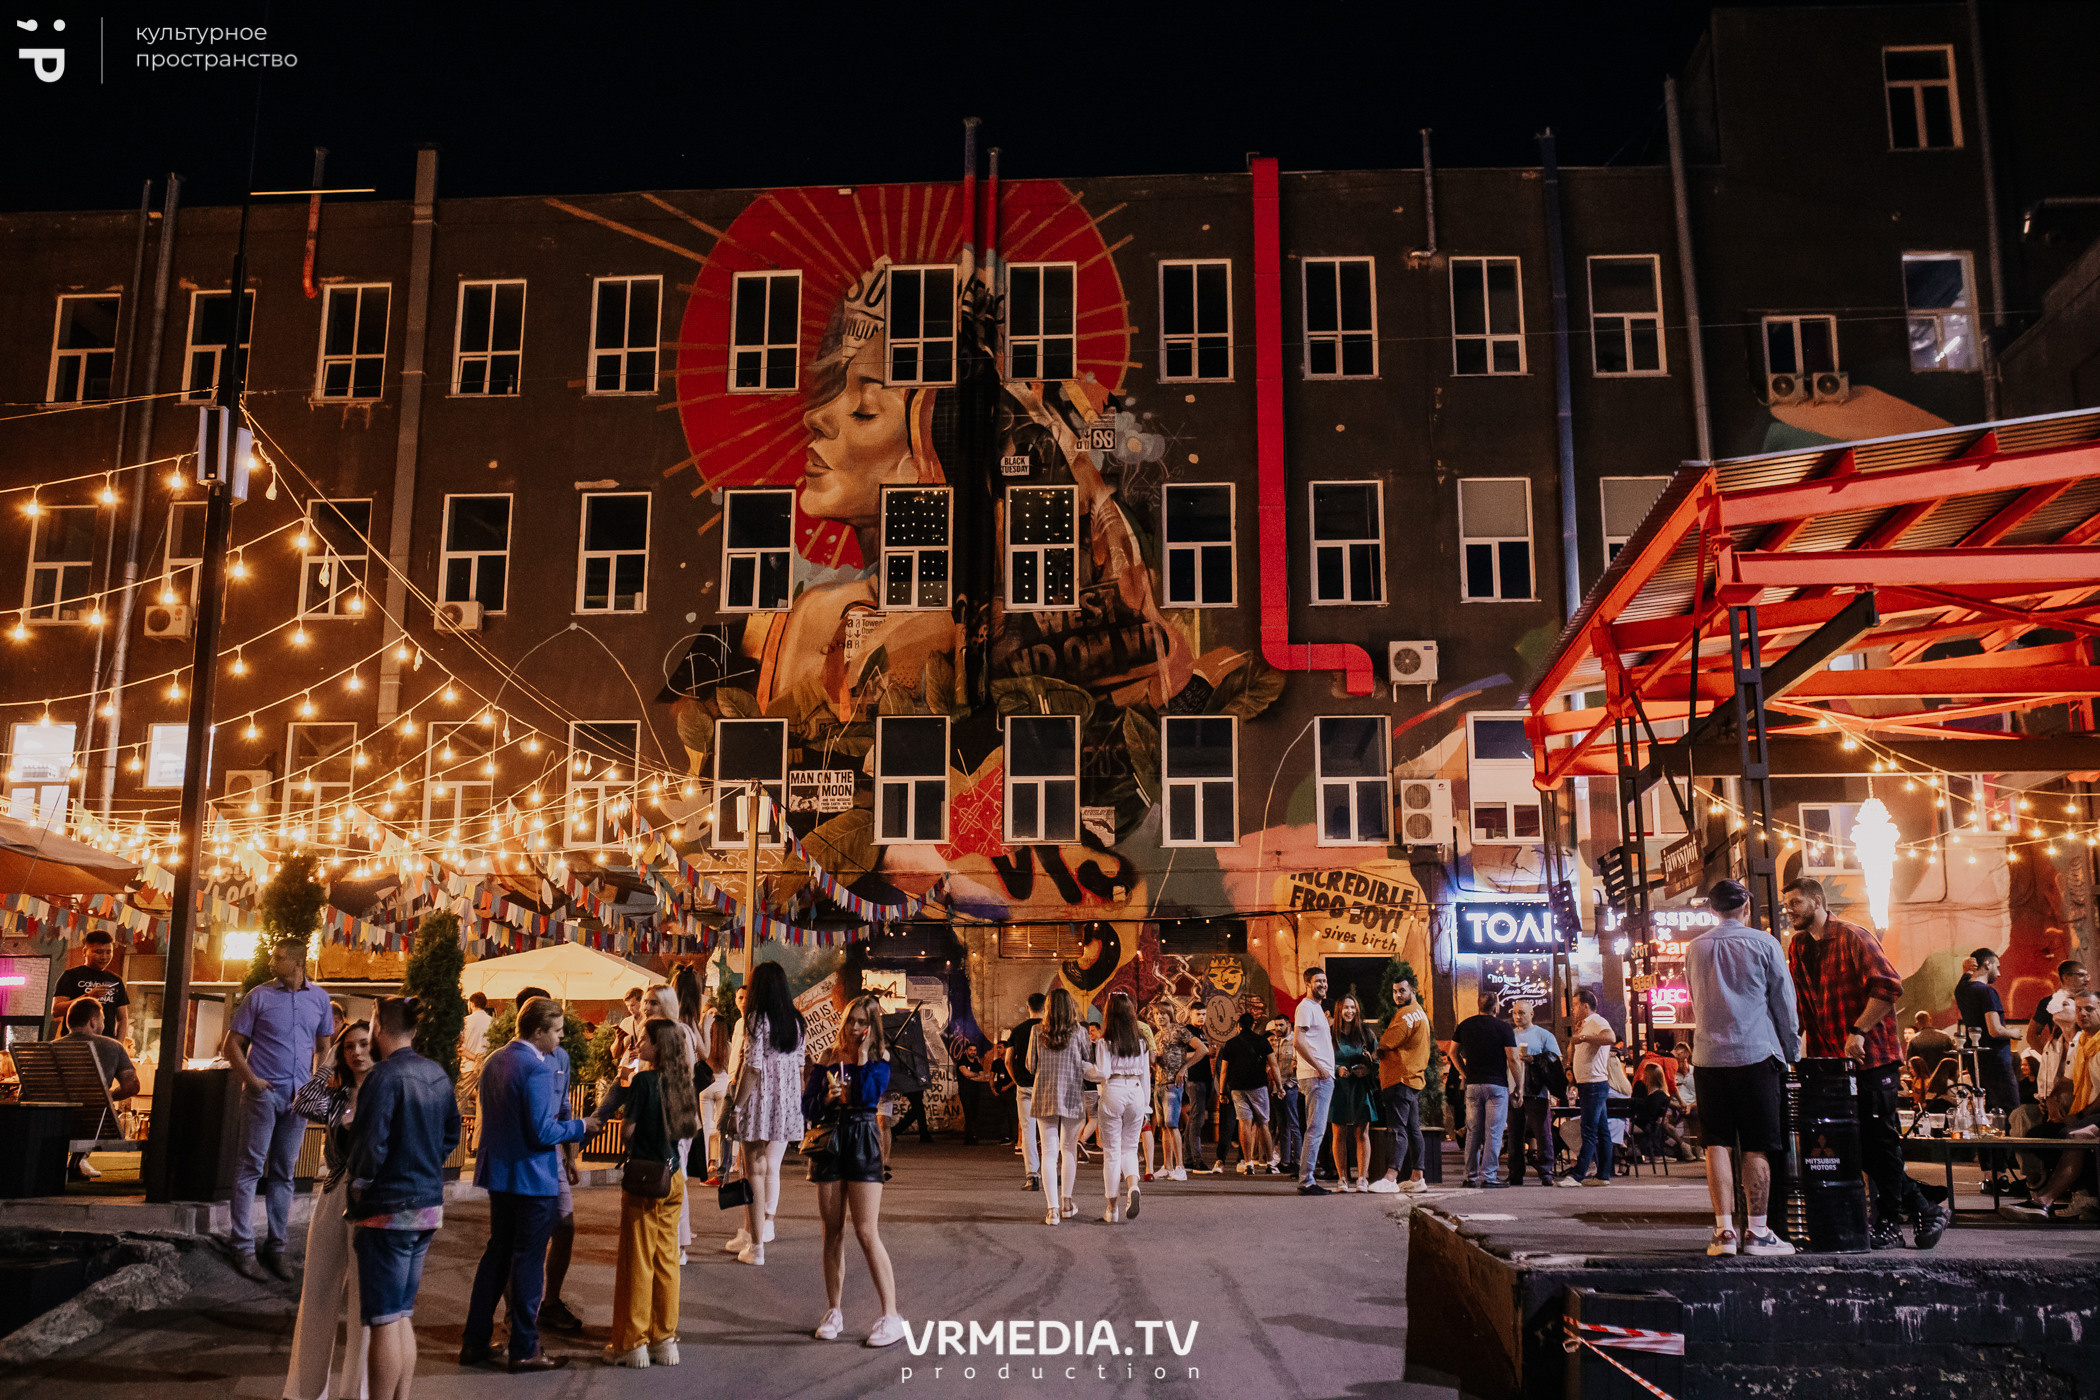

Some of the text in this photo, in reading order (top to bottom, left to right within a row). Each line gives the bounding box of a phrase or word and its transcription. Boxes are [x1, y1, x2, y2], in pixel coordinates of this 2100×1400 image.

[1004, 457, 1025, 466] BLACK
[1001, 465, 1029, 474] TUESDAY
[791, 771, 853, 784] MAN ON THE
[821, 784, 852, 797] MOON
[1321, 925, 1398, 952] gives birth
[1630, 944, 1649, 959] SPOT
[805, 1004, 831, 1026] HO IS
[806, 1021, 827, 1039] JACK
